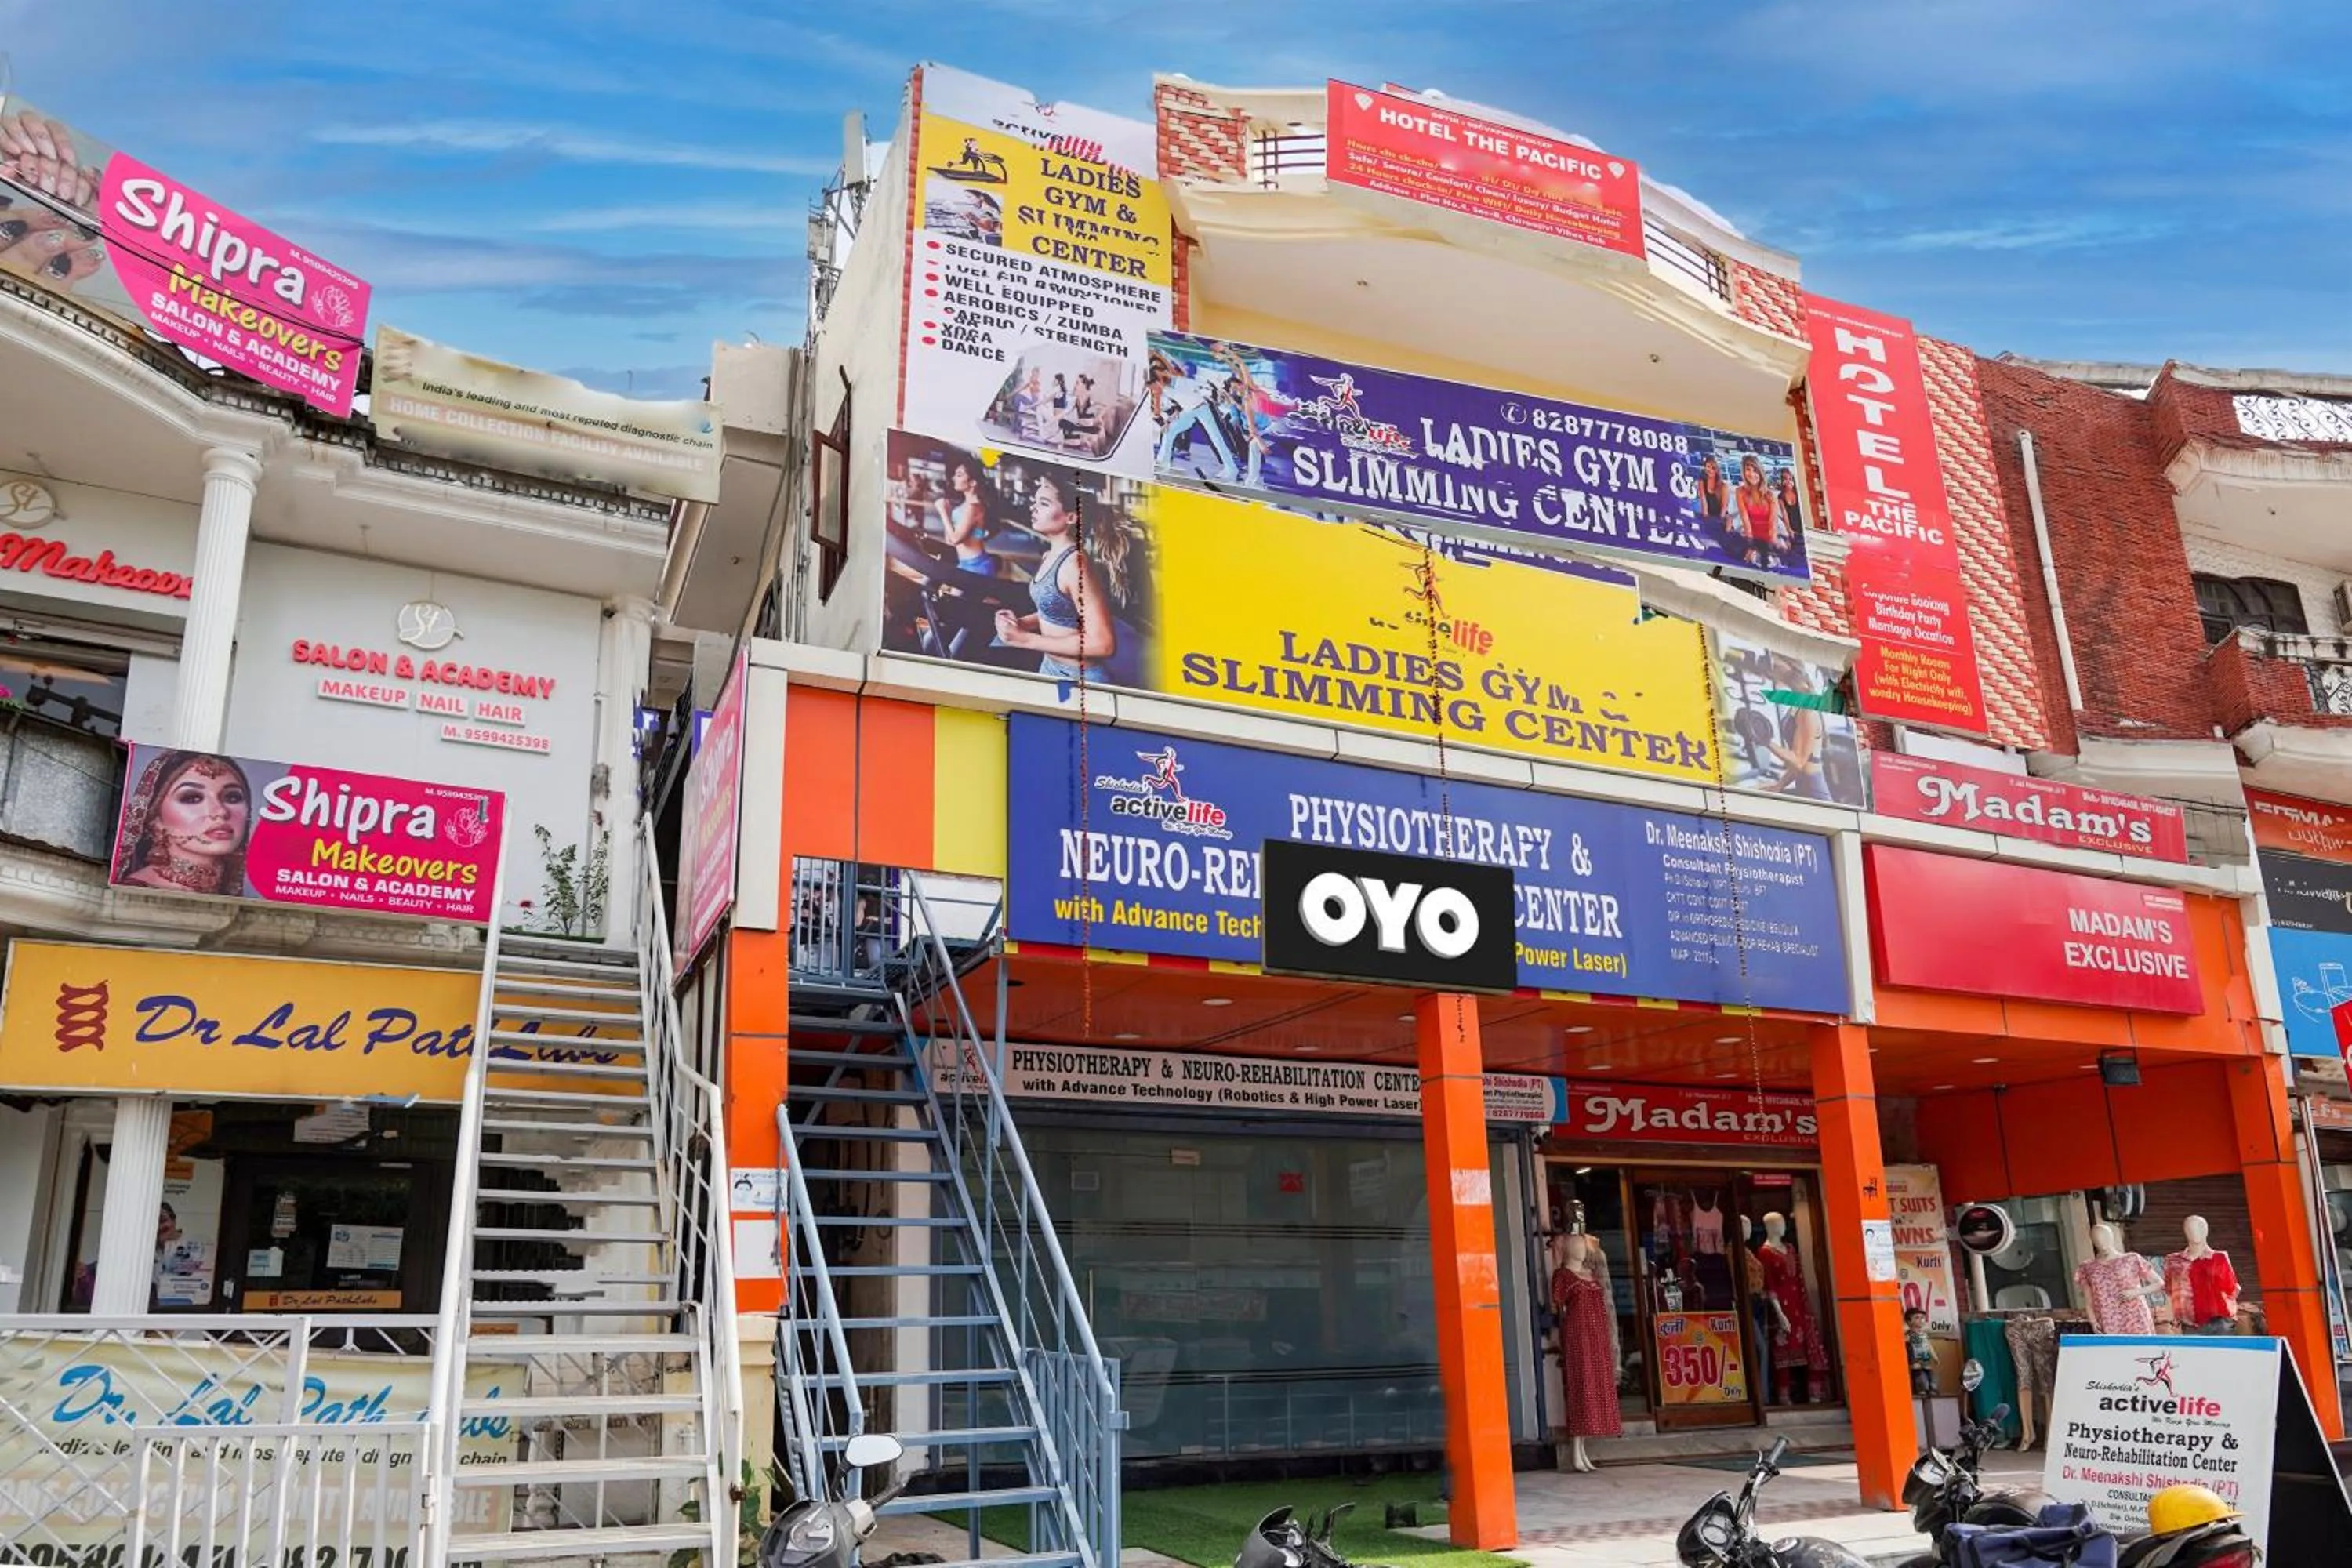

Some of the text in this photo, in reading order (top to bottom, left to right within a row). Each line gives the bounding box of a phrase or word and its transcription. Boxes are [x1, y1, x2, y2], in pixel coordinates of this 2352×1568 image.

[1380, 107, 1457, 143] HOTEL
[1463, 130, 1509, 155] THE
[1516, 144, 1602, 180] PACIFIC
[1040, 158, 1142, 198] LADIES
[1045, 186, 1137, 223] GYM &
[115, 179, 307, 306] Shipra
[1032, 236, 1146, 278] CENTER
[946, 243, 1033, 273] SECURED
[1039, 266, 1161, 303] ATMOSPHERE
[943, 291, 1039, 321] AEROBICS
[1058, 317, 1123, 340] ZUMBA
[945, 274, 994, 296] WELL
[1001, 285, 1094, 318] EQUIPPED
[169, 263, 343, 372] Makeovers
[151, 292, 342, 392] SALON & ACADEMY
[151, 311, 338, 404] MAKEUP NAILS BEAUTY HAIR
[942, 339, 1005, 362] DANCE
[391, 397, 704, 470] HOME COLLECTION FACILITY AVAILABLE
[422, 381, 713, 449] India's leading and most reputed diagnostic chain
[1533, 408, 1689, 455] 8287778088
[1834, 326, 1911, 501] HOTEL
[1420, 416, 1563, 477] LADIES
[1574, 444, 1659, 494] GYM
[1671, 462, 1697, 499] &
[1292, 445, 1519, 523] SLIMMING
[1844, 510, 1945, 546] PACIFIC
[1864, 499, 1918, 524] THE
[1875, 601, 1942, 629] Birthday Party
[292, 639, 556, 700] SALON & ACADEMY
[1279, 630, 1465, 691] LADIES
[1880, 645, 1918, 666] Monthly
[1885, 660, 1899, 673] For
[1901, 664, 1928, 679] Night
[322, 680, 522, 721] MAKEUP NAIL HAIR
[1181, 652, 1712, 771] SLIMMING CENTER
[444, 725, 461, 738] M.
[259, 775, 436, 844] Shipra
[1112, 797, 1226, 827] activelife
[1917, 775, 2153, 844] Madam's
[1290, 793, 1592, 876] PHYSIOTHERAPY &
[1646, 822, 1664, 846] Dr.
[1735, 833, 1791, 864] Shishodia
[1794, 843, 1818, 873] (PT)
[2078, 834, 2154, 855] EXCLUSIVE
[311, 838, 477, 884] Makeovers
[275, 885, 474, 913] MAKEUP NAILS BEAUTY HAIR
[277, 869, 475, 902] SALON & ACADEMY
[1298, 871, 1479, 959] OYO
[2068, 908, 2173, 945] MADAM'S
[1054, 895, 1104, 924] with
[1112, 900, 1208, 934] Advance
[1515, 942, 1567, 969] Power
[1573, 949, 1628, 978] Laser)
[2063, 941, 2190, 979] EXCLUSIVE
[135, 995, 353, 1051] Dr Lal
[1013, 1050, 1420, 1092] PHYSIOTHERAPY & NEURO-REHABILITATION CENTE
[1022, 1078, 1423, 1112] with Advance Technology (Robotics & High Power Laser)
[1584, 1096, 1817, 1135] Madam's
[1900, 1196, 1936, 1213] SUITS
[1931, 1320, 1951, 1331] Only
[1664, 1344, 1738, 1388] 350/-
[2085, 1380, 2140, 1392] Shishodia's
[2100, 1394, 2221, 1417] activelife
[2166, 1417, 2183, 1426] Keep
[2186, 1418, 2200, 1428] You
[2203, 1419, 2231, 1428] Moving
[2063, 1442, 2238, 1473] Neuro-Rehabilitation Center
[2067, 1421, 2238, 1452] Physiotherapy &
[2063, 1466, 2240, 1500] Dr. Meenakshi (PT)
